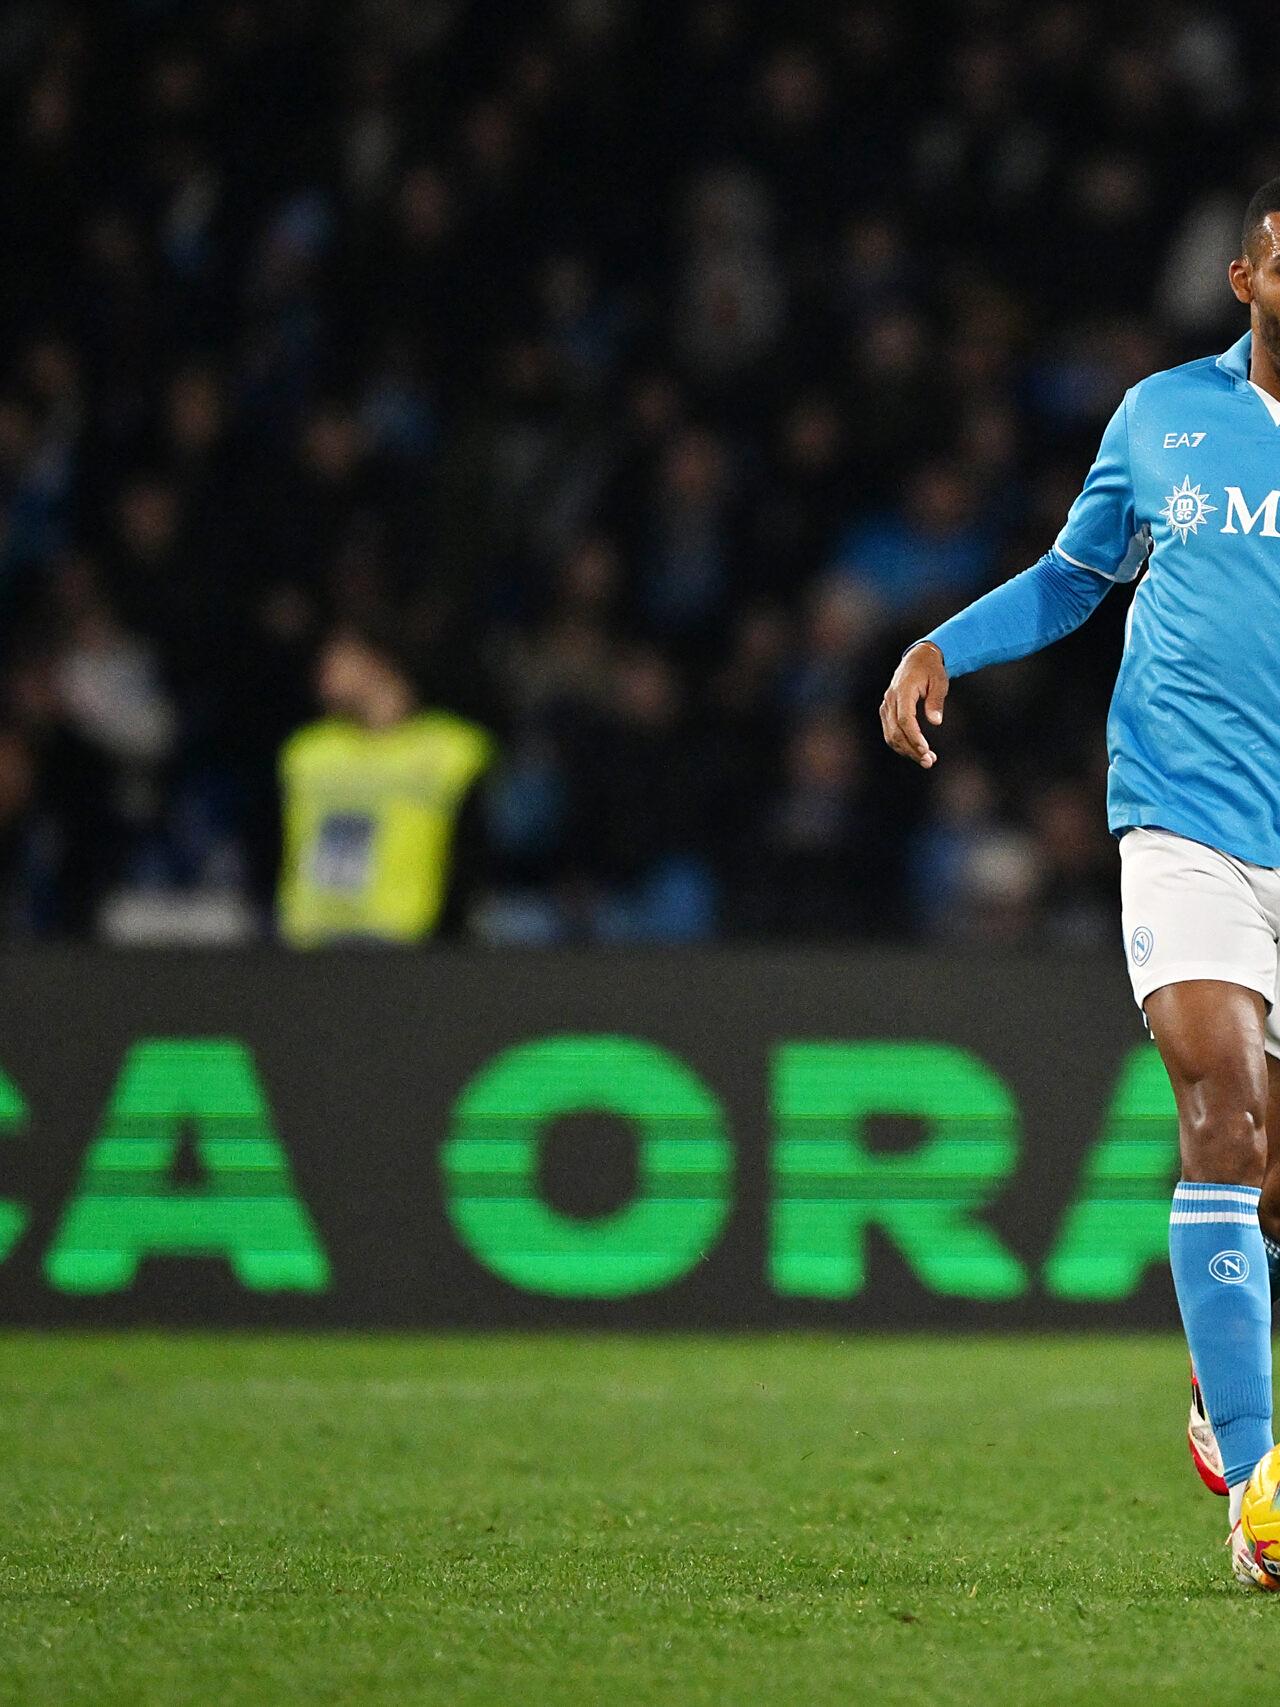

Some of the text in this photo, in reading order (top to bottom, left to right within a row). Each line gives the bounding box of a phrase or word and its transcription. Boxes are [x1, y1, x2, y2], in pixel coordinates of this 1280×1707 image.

[1163, 432, 1207, 449] EA7
[0, 1037, 332, 1296] A
[1223, 1258, 1242, 1275] N
